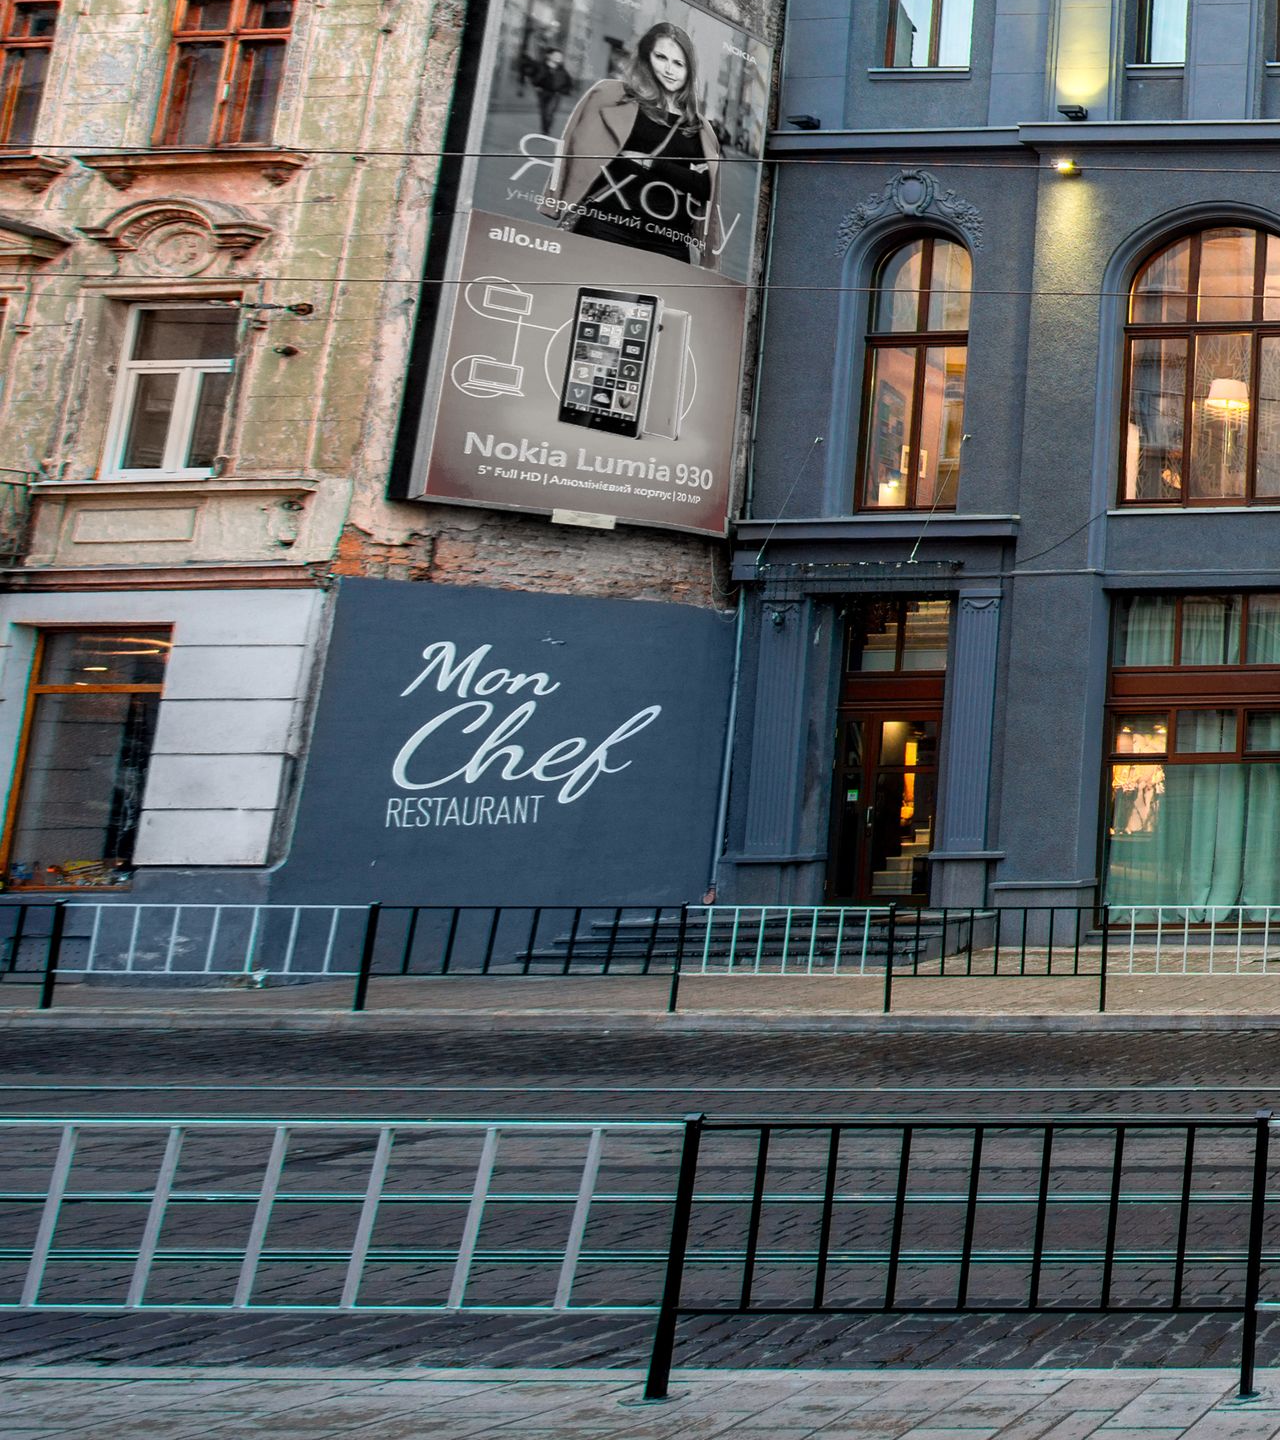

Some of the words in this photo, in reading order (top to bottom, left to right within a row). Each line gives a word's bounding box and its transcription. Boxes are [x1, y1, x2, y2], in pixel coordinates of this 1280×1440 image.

[723, 42, 758, 64] NOKIA
[510, 133, 565, 192] Я
[488, 225, 562, 254] allo.ua
[504, 186, 642, 230] універсальний
[645, 221, 707, 251] смартфон
[463, 431, 568, 468] Nokia
[576, 448, 670, 482] Lumia
[675, 463, 713, 490] 930
[494, 467, 517, 480] Full
[520, 471, 541, 483] HD
[633, 488, 672, 501] корпус
[400, 641, 561, 698] Mon
[393, 700, 662, 804] Chef
[385, 795, 545, 828] RESTAURANT
